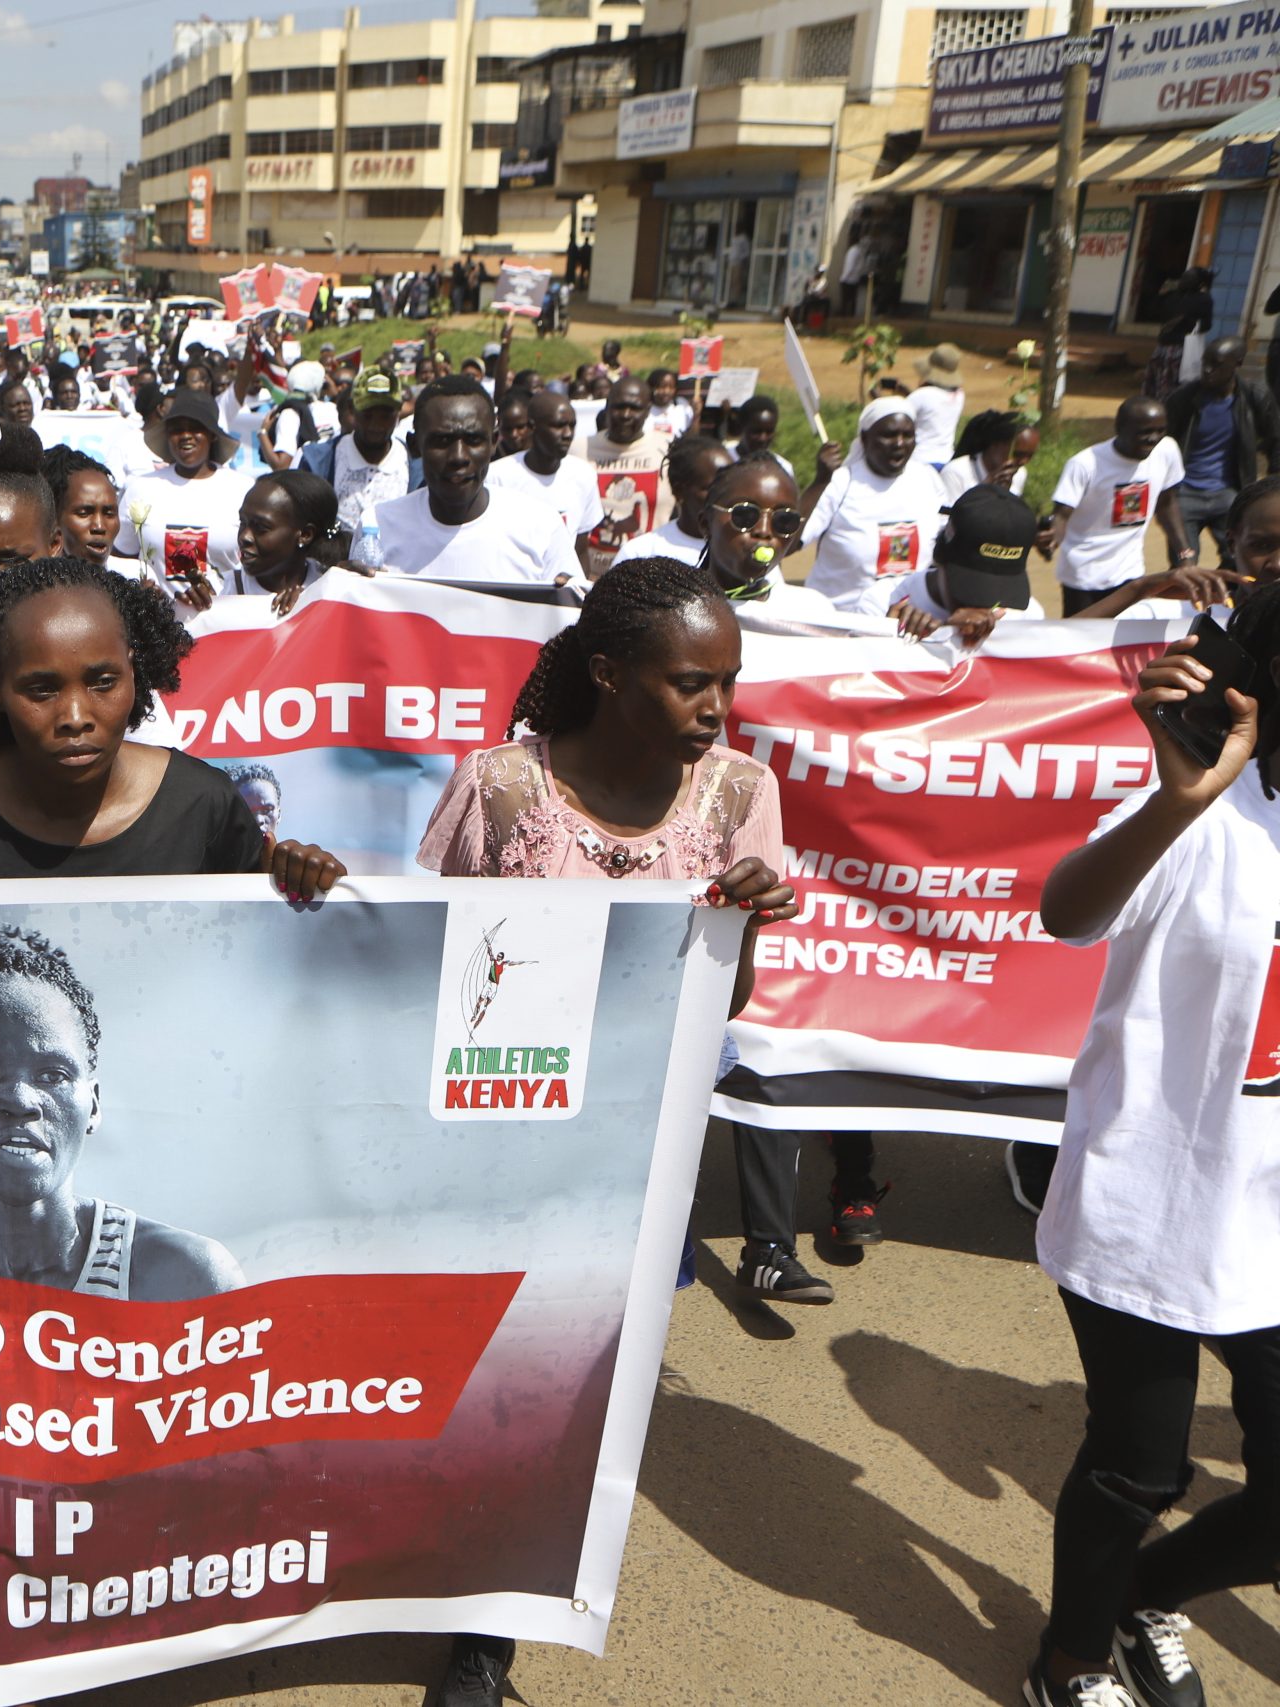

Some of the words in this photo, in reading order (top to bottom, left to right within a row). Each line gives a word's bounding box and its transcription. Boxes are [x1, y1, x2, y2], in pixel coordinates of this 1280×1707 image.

[1142, 15, 1230, 54] JULIAN
[936, 52, 988, 90] SKYLA
[1112, 60, 1167, 81] LABORATORY
[1185, 44, 1261, 70] CONSULTATION
[211, 683, 365, 744] NOT
[385, 686, 486, 741] BE
[873, 739, 1156, 800] SENTE
[753, 934, 997, 984] ENOTSAFE
[445, 1047, 570, 1074] ATHLETICS
[445, 1079, 569, 1109] KENYA
[23, 1310, 272, 1383] Gender
[135, 1368, 423, 1444] Violence
[6, 1531, 328, 1630] Cheptegei
